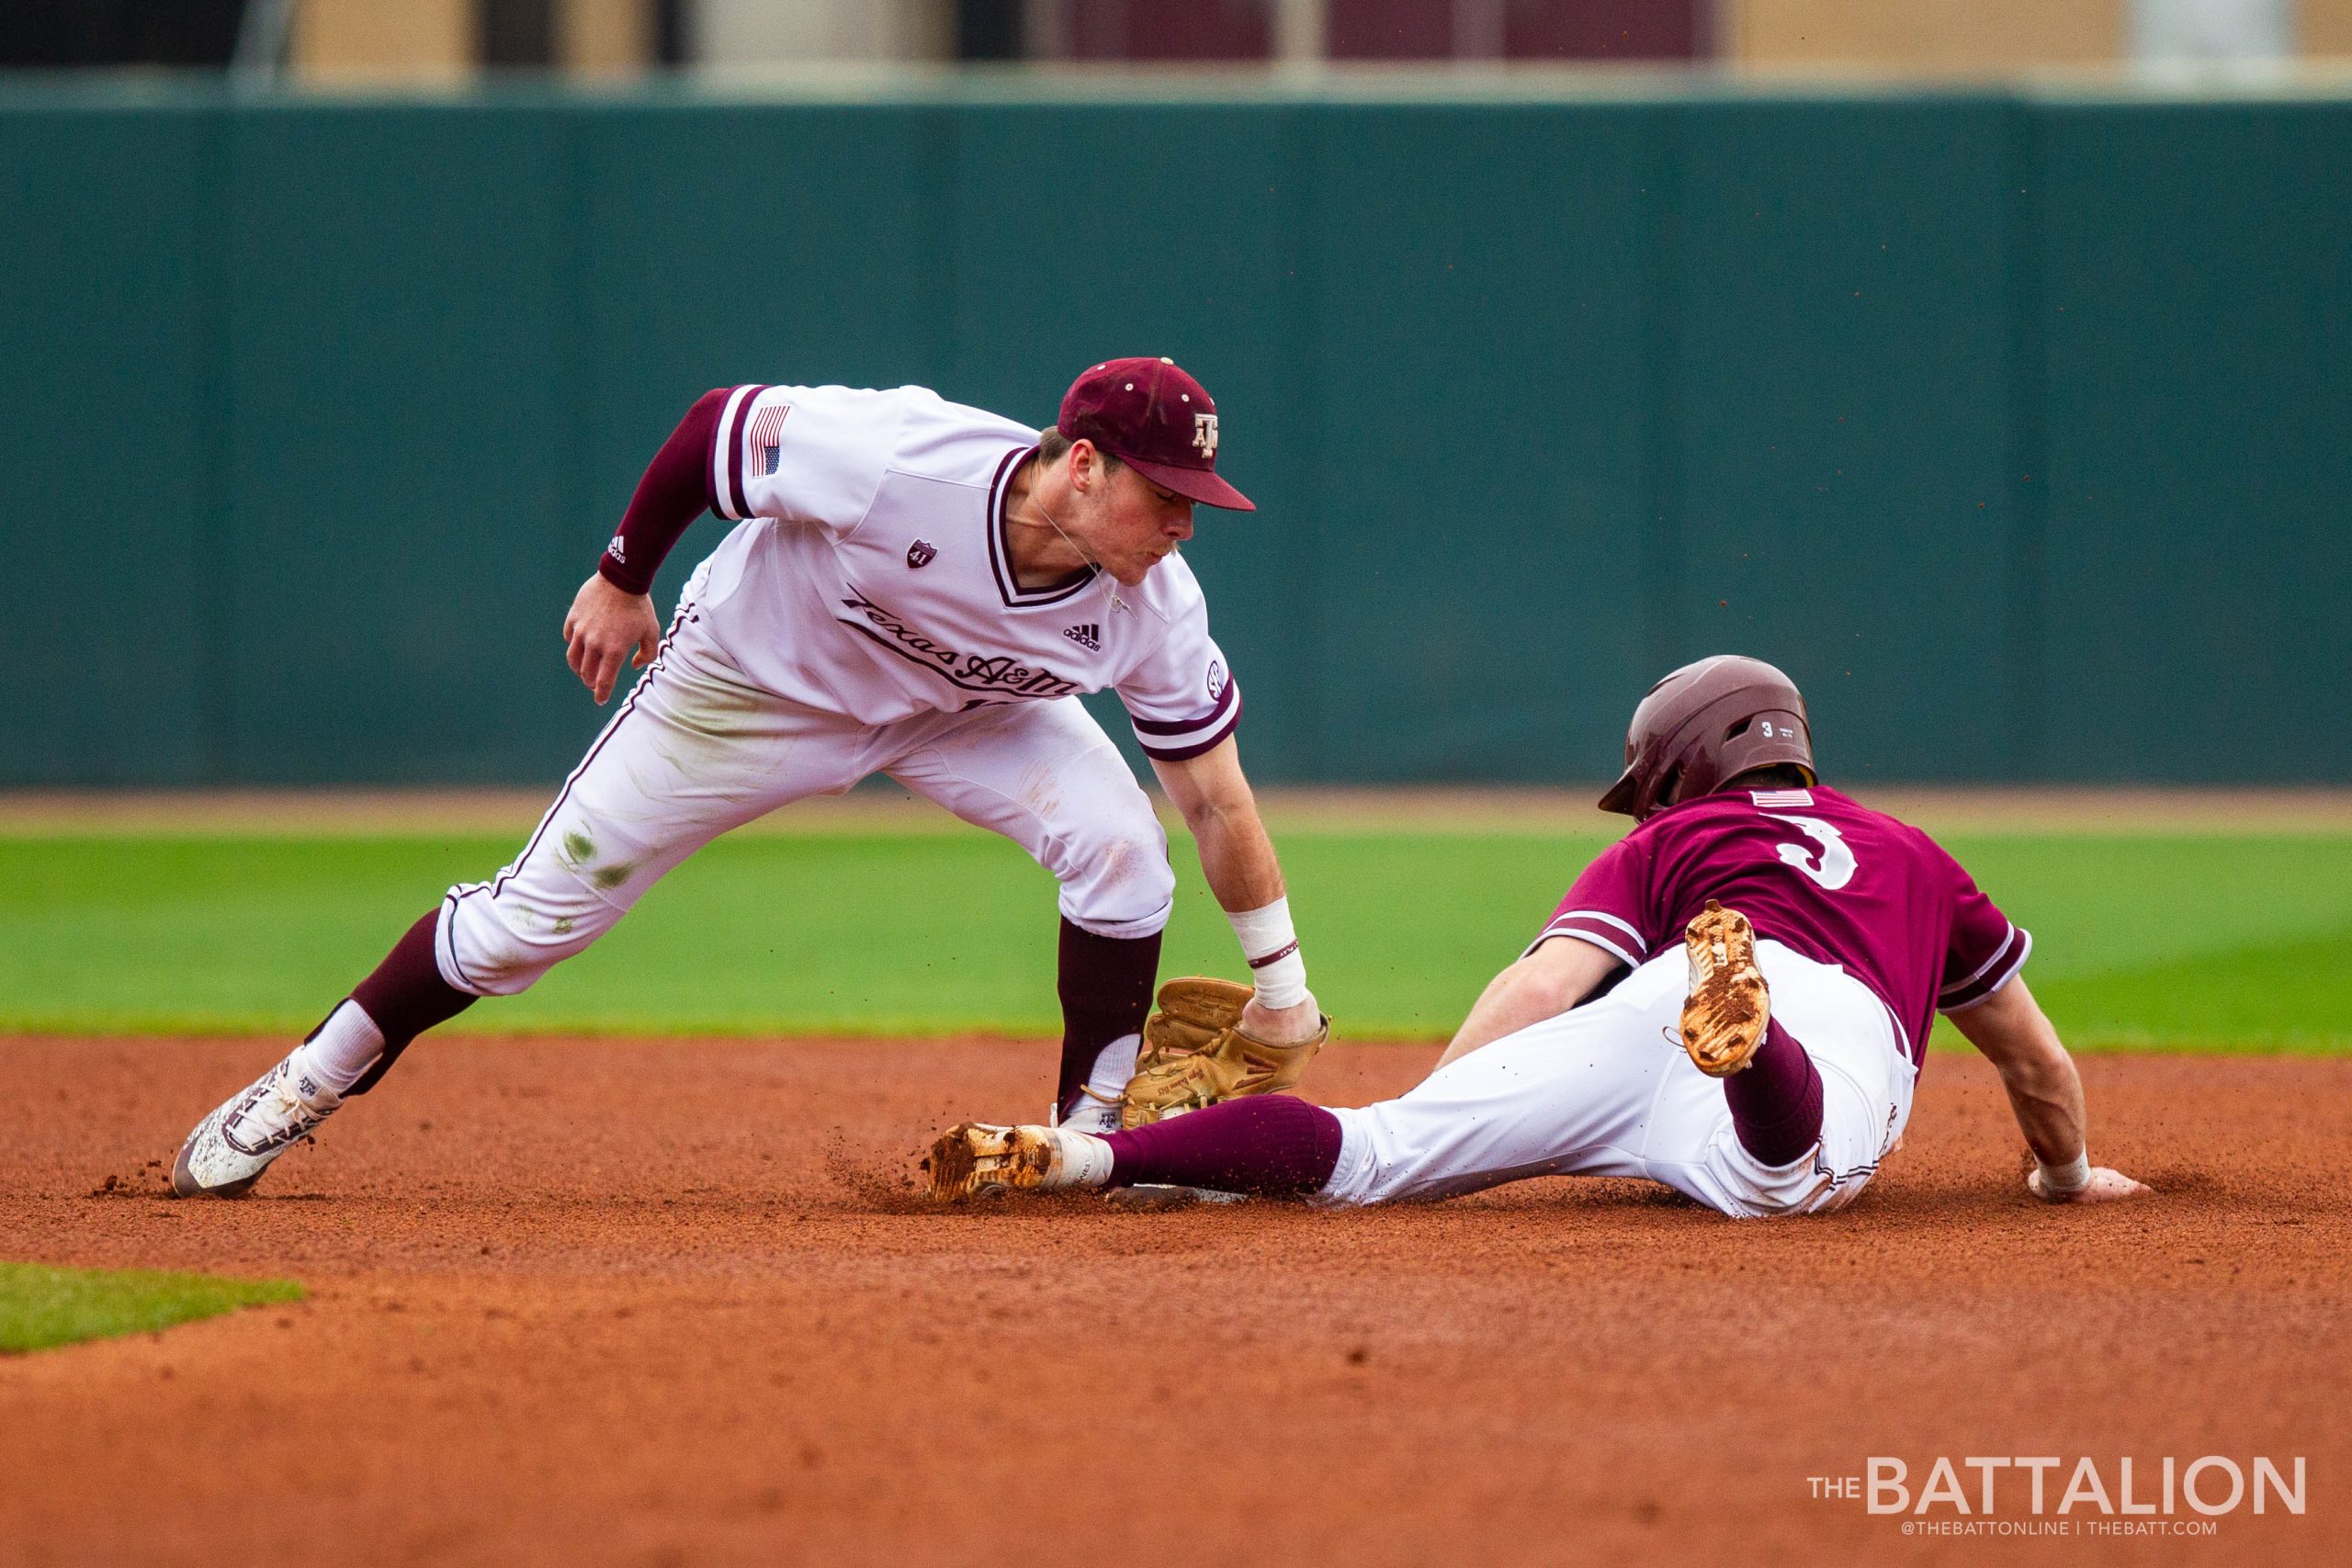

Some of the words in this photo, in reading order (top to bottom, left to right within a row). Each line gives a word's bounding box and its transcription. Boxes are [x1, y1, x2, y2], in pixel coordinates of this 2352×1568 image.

[910, 551, 927, 565] 41
[842, 582, 959, 665] Texas
[955, 656, 1079, 694] A&M
[1063, 628, 1101, 652] adidas
[1761, 721, 1773, 738] 3
[1758, 812, 1859, 890] 3
